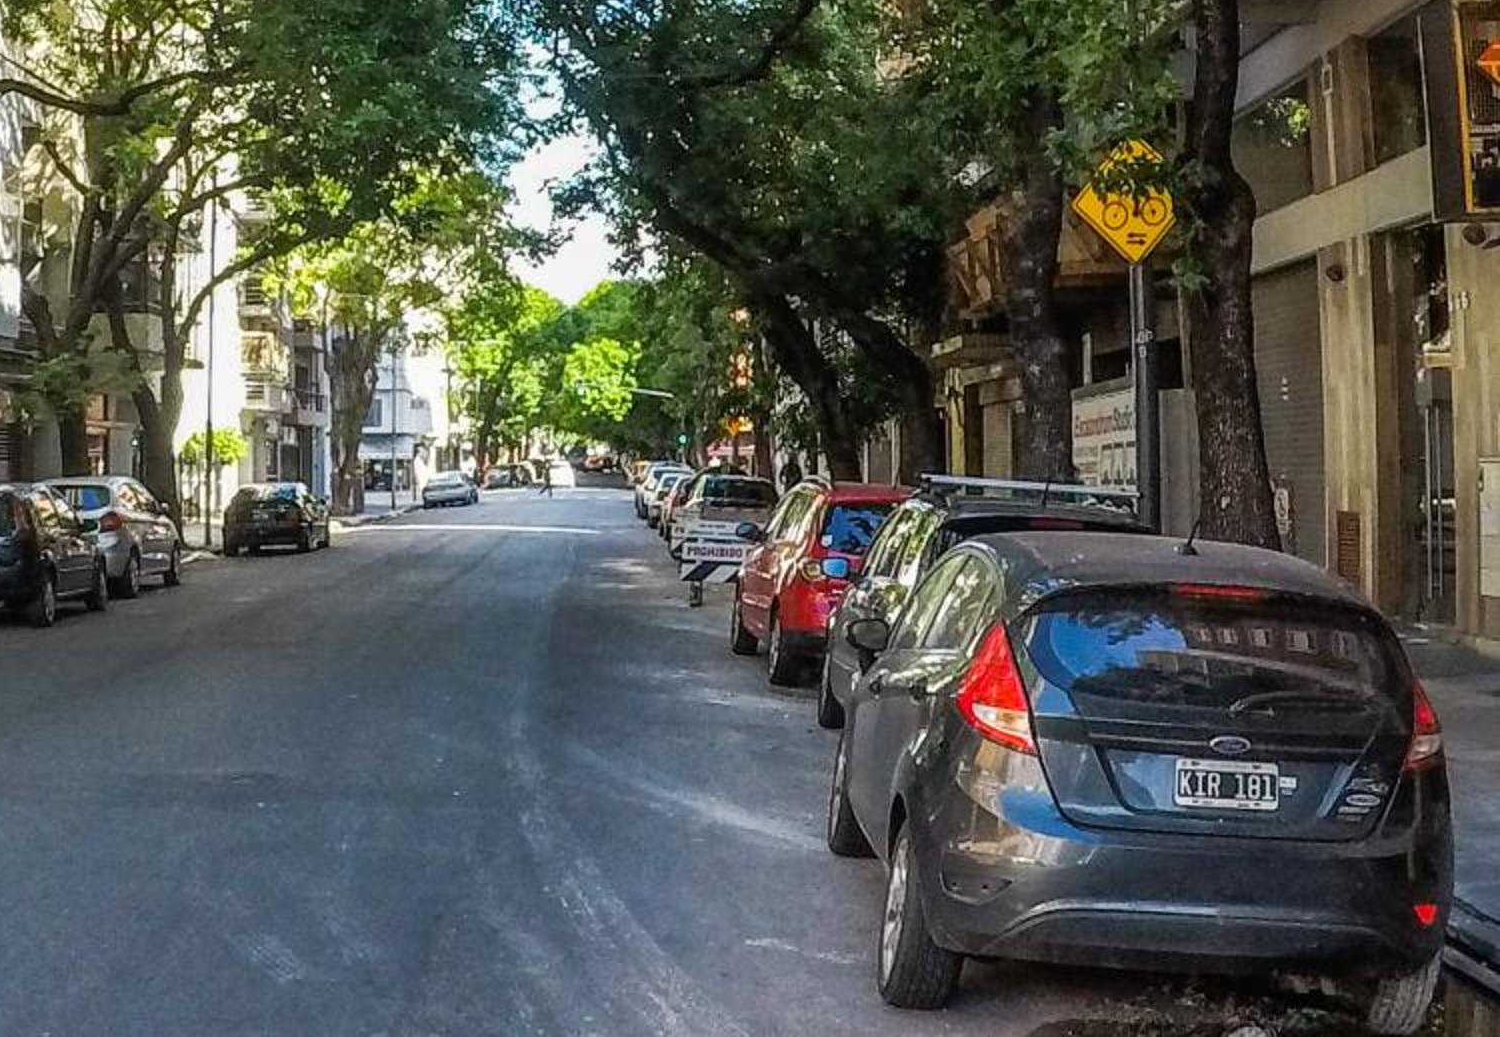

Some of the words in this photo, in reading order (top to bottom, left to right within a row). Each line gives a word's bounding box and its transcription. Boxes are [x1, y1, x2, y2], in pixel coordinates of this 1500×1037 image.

[686, 545, 743, 559] PROHIBIDO
[1179, 770, 1221, 798] KIR
[1235, 774, 1275, 800] 181
